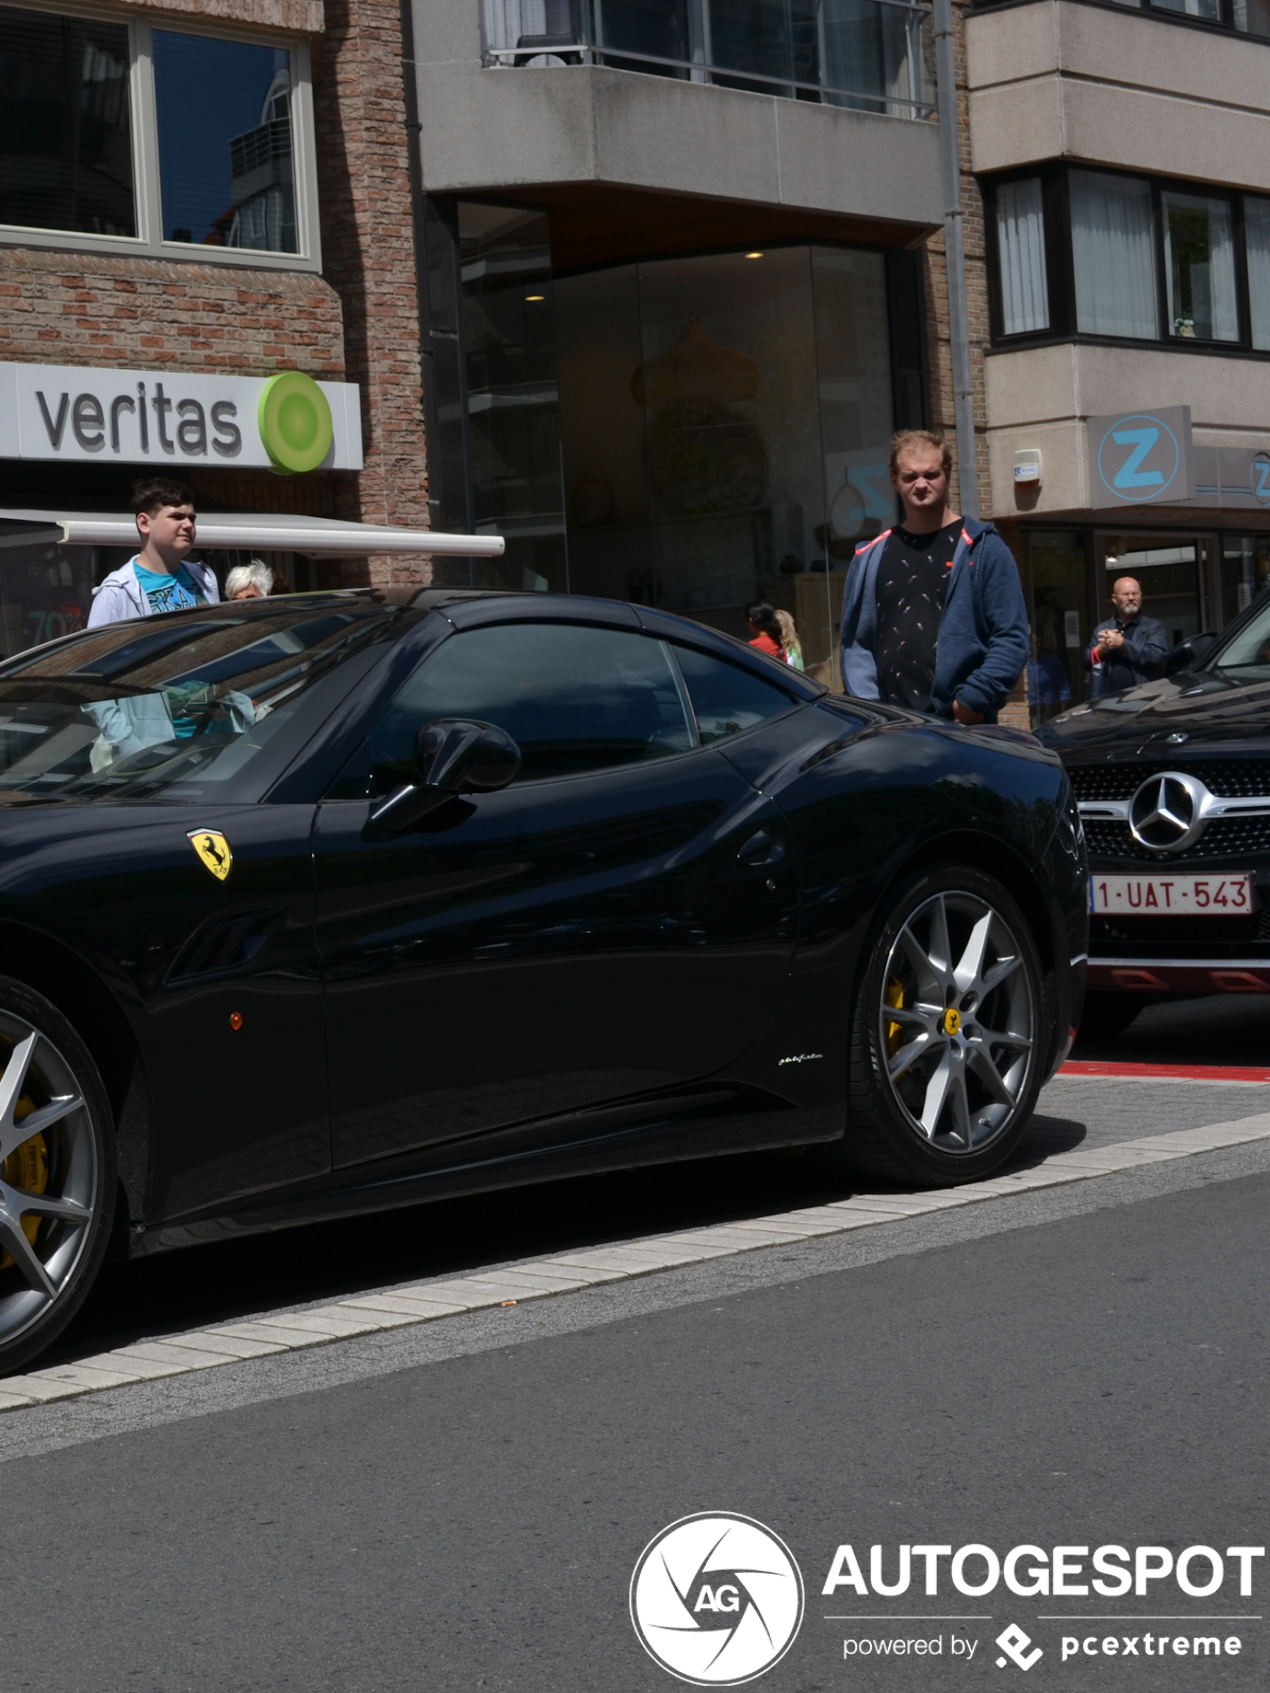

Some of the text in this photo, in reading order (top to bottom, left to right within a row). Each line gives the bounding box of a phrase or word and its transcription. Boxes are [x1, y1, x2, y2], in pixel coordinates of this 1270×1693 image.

[34, 382, 243, 455] veritas
[1112, 427, 1165, 489] Z
[1099, 881, 1247, 908] 1-UAT-543
[29, 1146, 38, 1186] Ferrari
